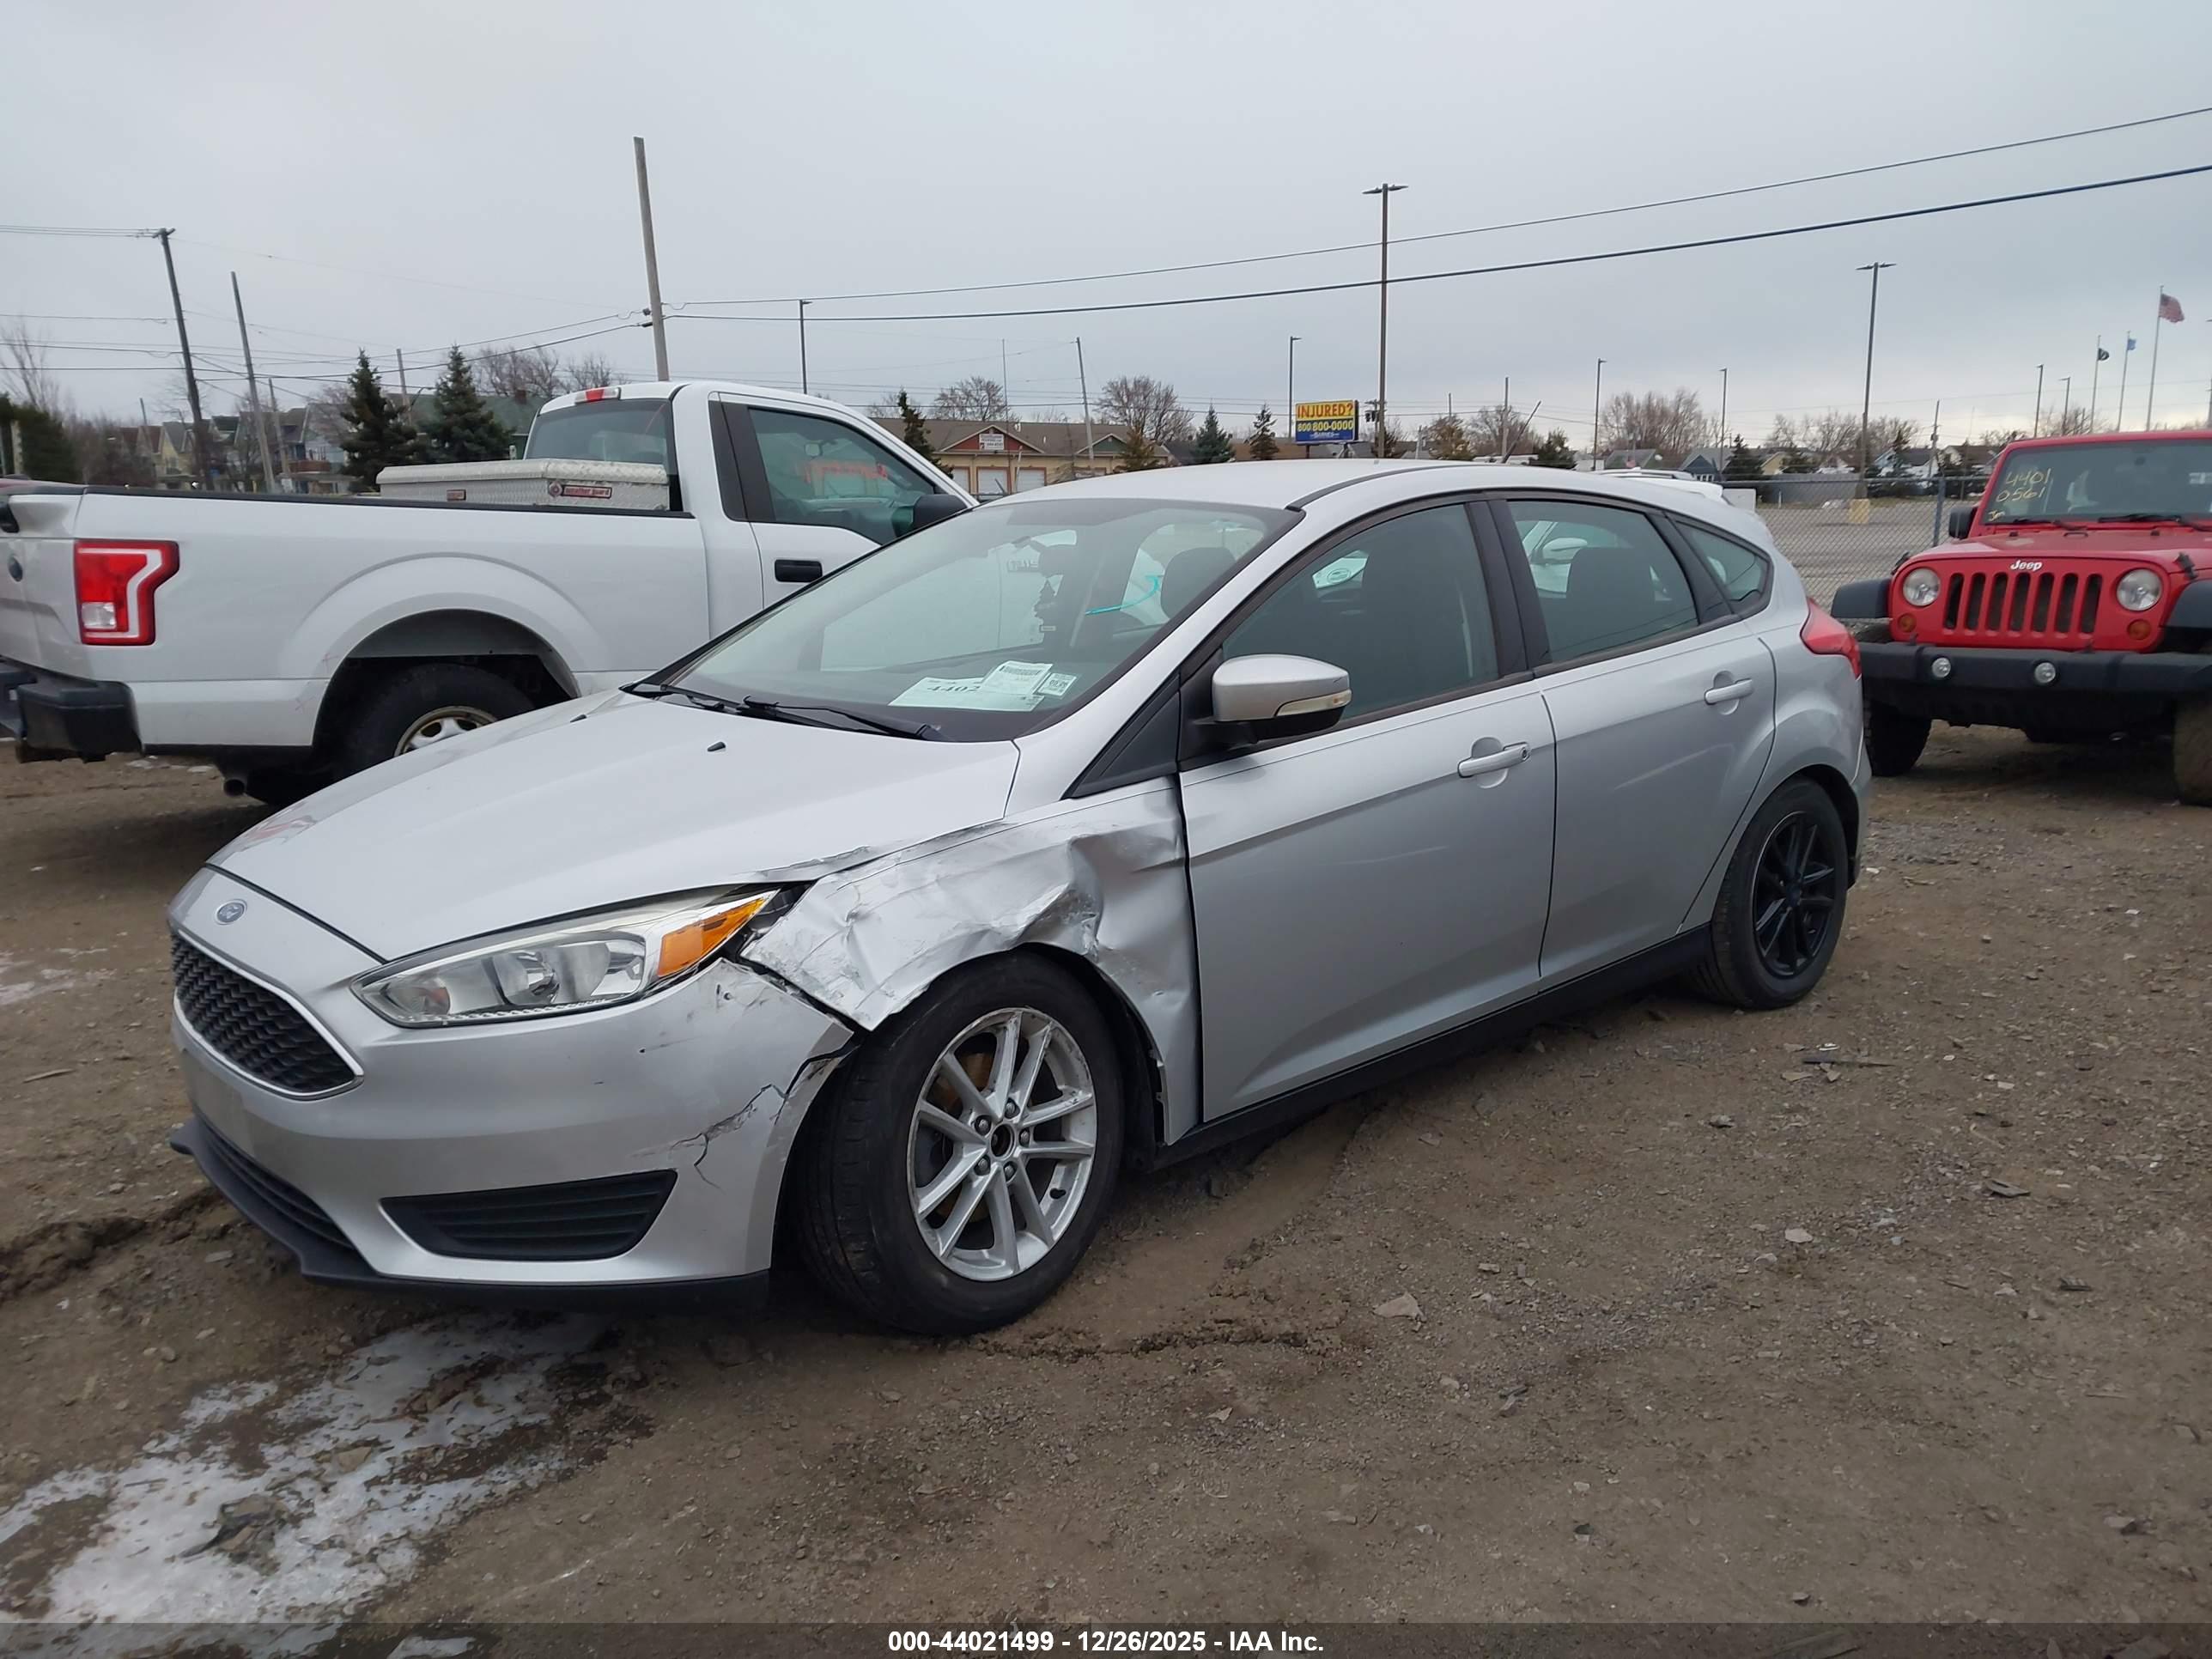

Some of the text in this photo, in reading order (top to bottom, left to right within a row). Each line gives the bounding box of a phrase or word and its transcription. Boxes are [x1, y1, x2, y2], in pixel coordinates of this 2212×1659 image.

[1297, 403, 1353, 418] INJURED?
[1297, 420, 1353, 432] 800 800-0000
[2005, 468, 2051, 486] 4401
[1996, 486, 2046, 501] 0561
[2010, 559, 2042, 571] Jeep
